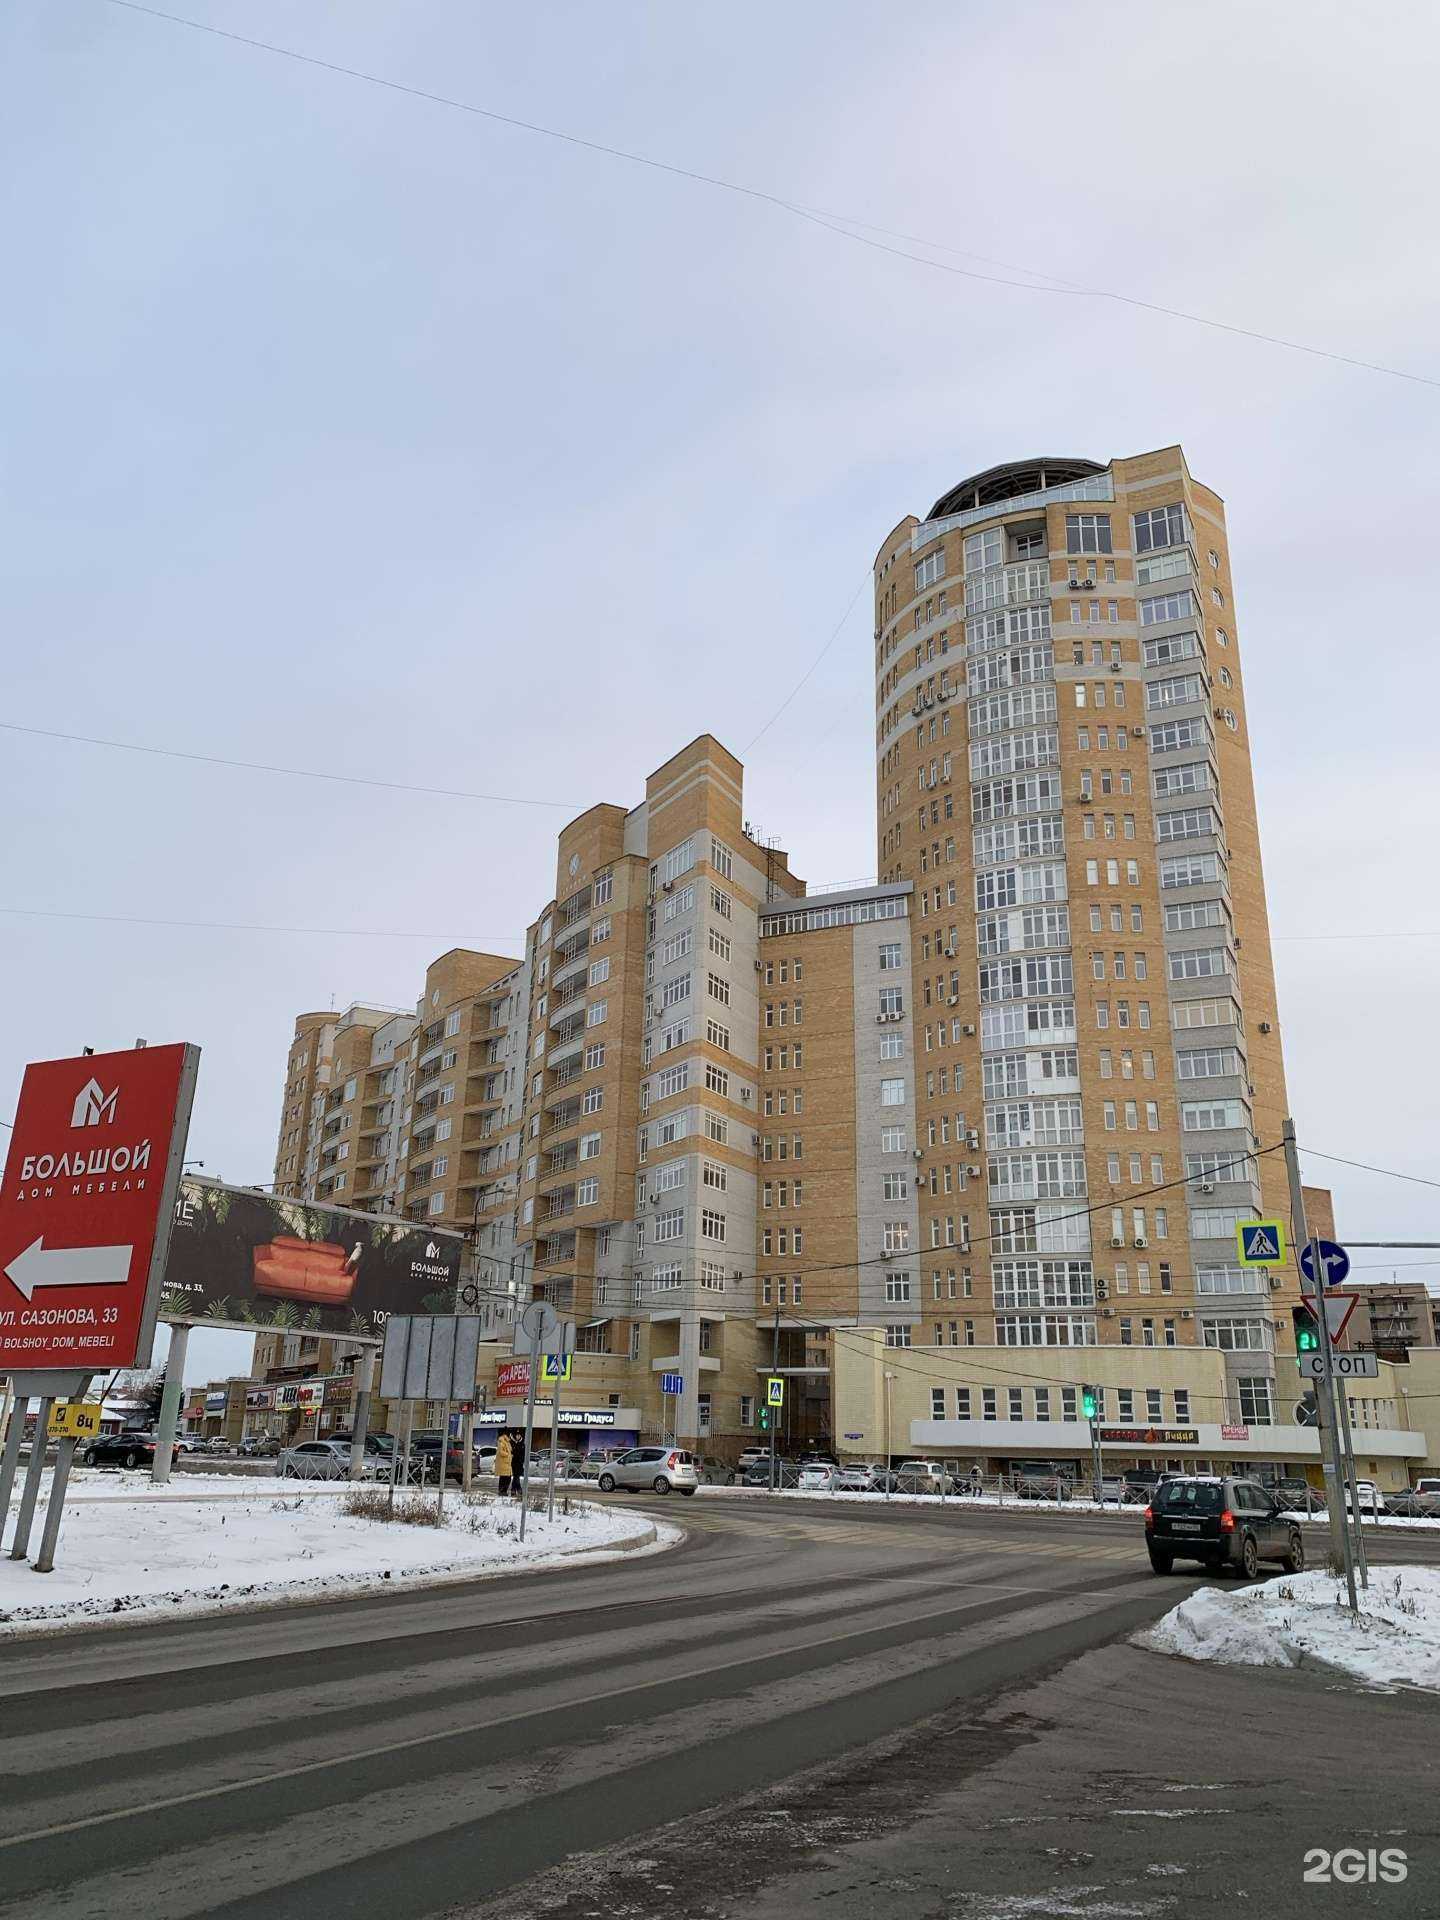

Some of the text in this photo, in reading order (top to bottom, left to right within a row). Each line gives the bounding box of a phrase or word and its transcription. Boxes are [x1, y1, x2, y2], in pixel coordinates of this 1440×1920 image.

[20, 1138, 152, 1182] БОЛЬШОЙ
[17, 1178, 145, 1201] ДОМ МЕБЕЛИ
[411, 1261, 450, 1277] БОЛЬШОЙ
[0, 1307, 118, 1326] УЛ. САЗОНОВА, 33
[3, 1336, 115, 1350] BOLSHOY_DOM_MEBELI
[1312, 1358, 1366, 1374] СОП
[584, 1412, 614, 1425] Градуса
[1222, 1425, 1248, 1434] АРЕНДА
